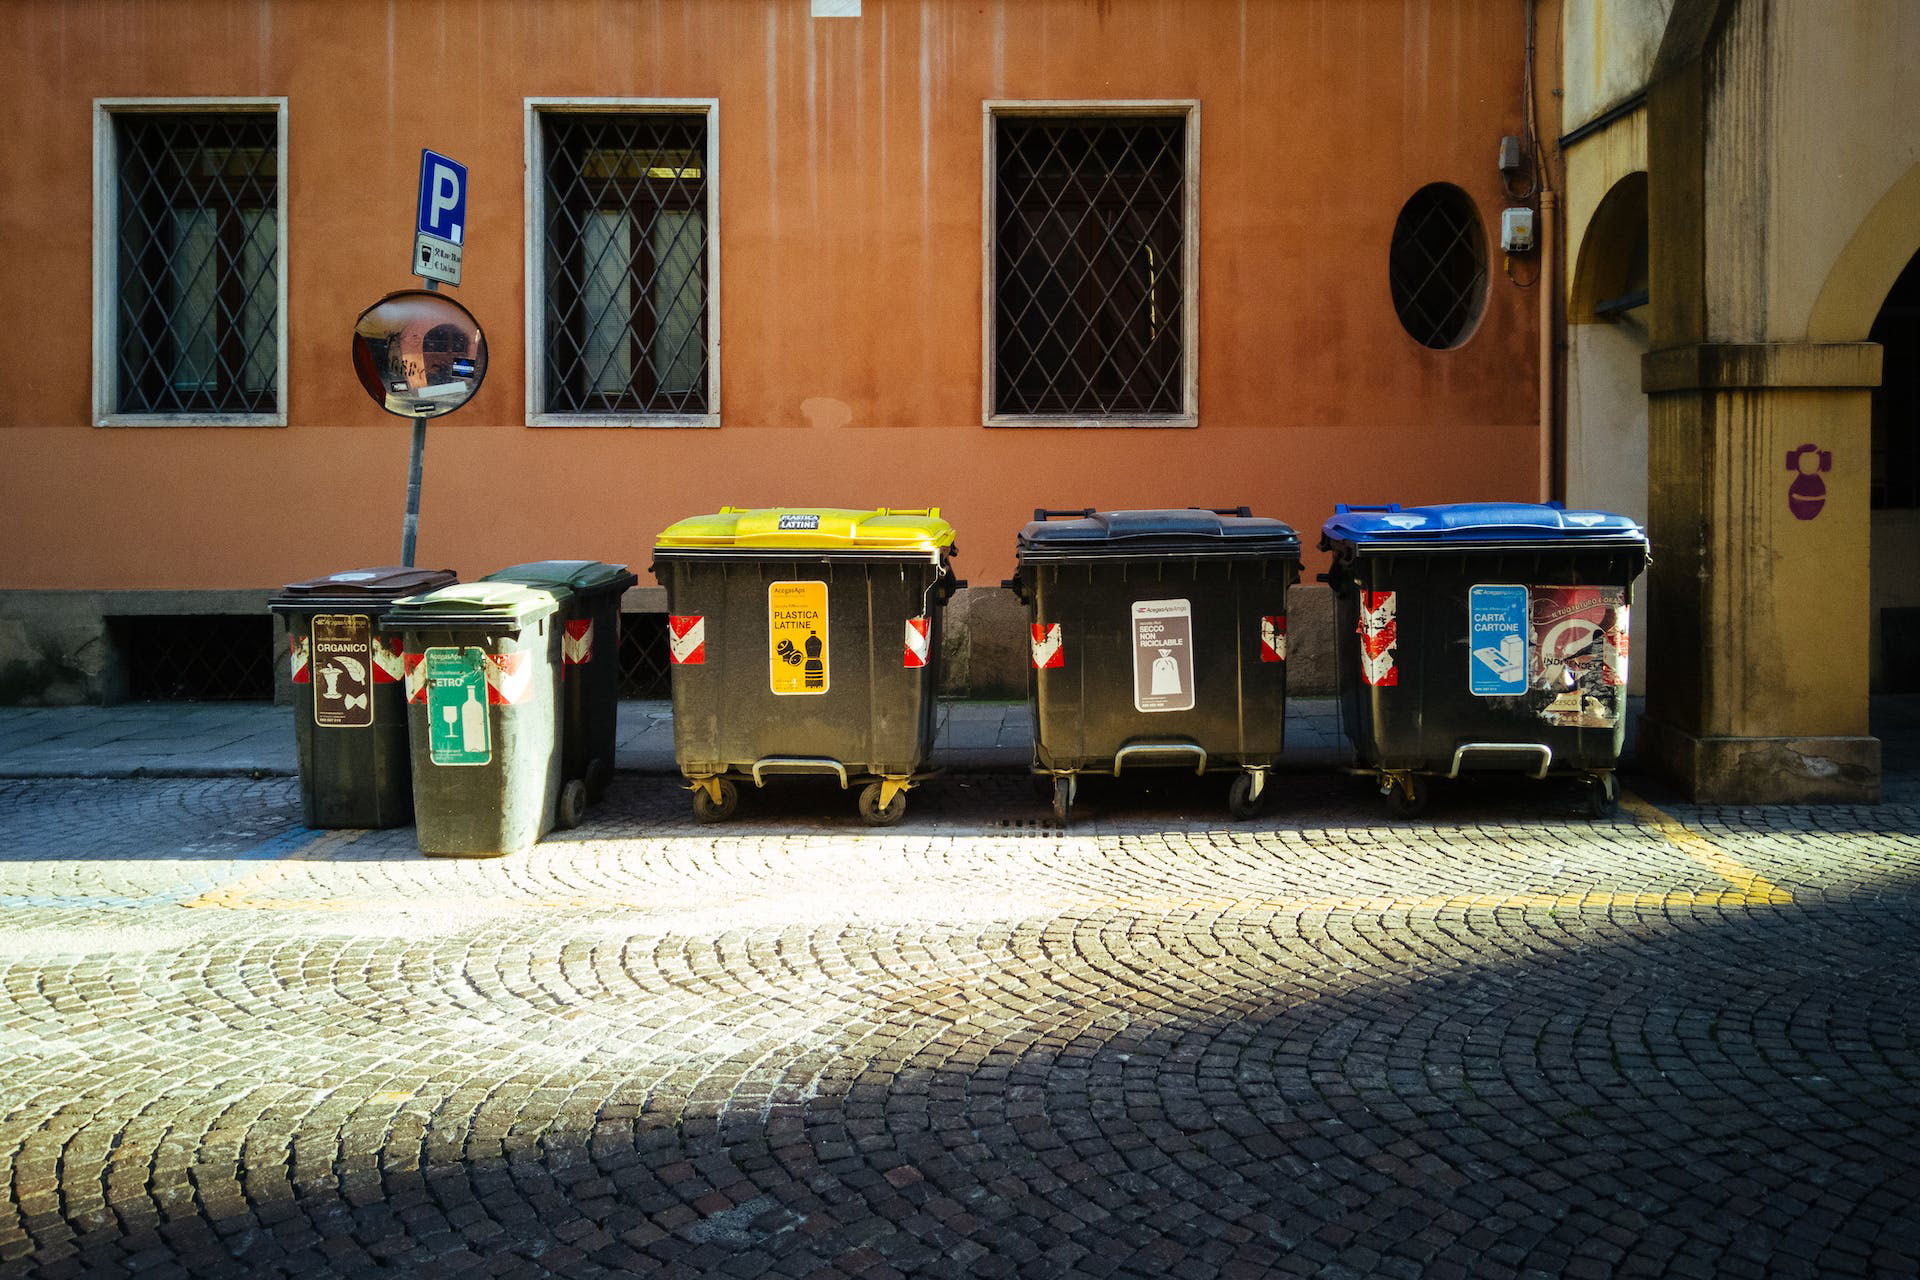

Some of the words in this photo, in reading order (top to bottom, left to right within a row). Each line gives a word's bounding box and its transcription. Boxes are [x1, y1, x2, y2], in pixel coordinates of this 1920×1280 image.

[430, 163, 459, 228] P
[781, 521, 816, 529] LATTINE
[774, 611, 819, 620] PLASTICA
[1474, 613, 1505, 622] CARTA
[774, 621, 811, 629] LATTINE
[1139, 625, 1165, 633] SECCO
[1474, 623, 1519, 632] CARTONE
[1140, 638, 1184, 648] RICICLABILE
[317, 643, 368, 653] ORGANICO
[430, 677, 464, 688] ETRO
